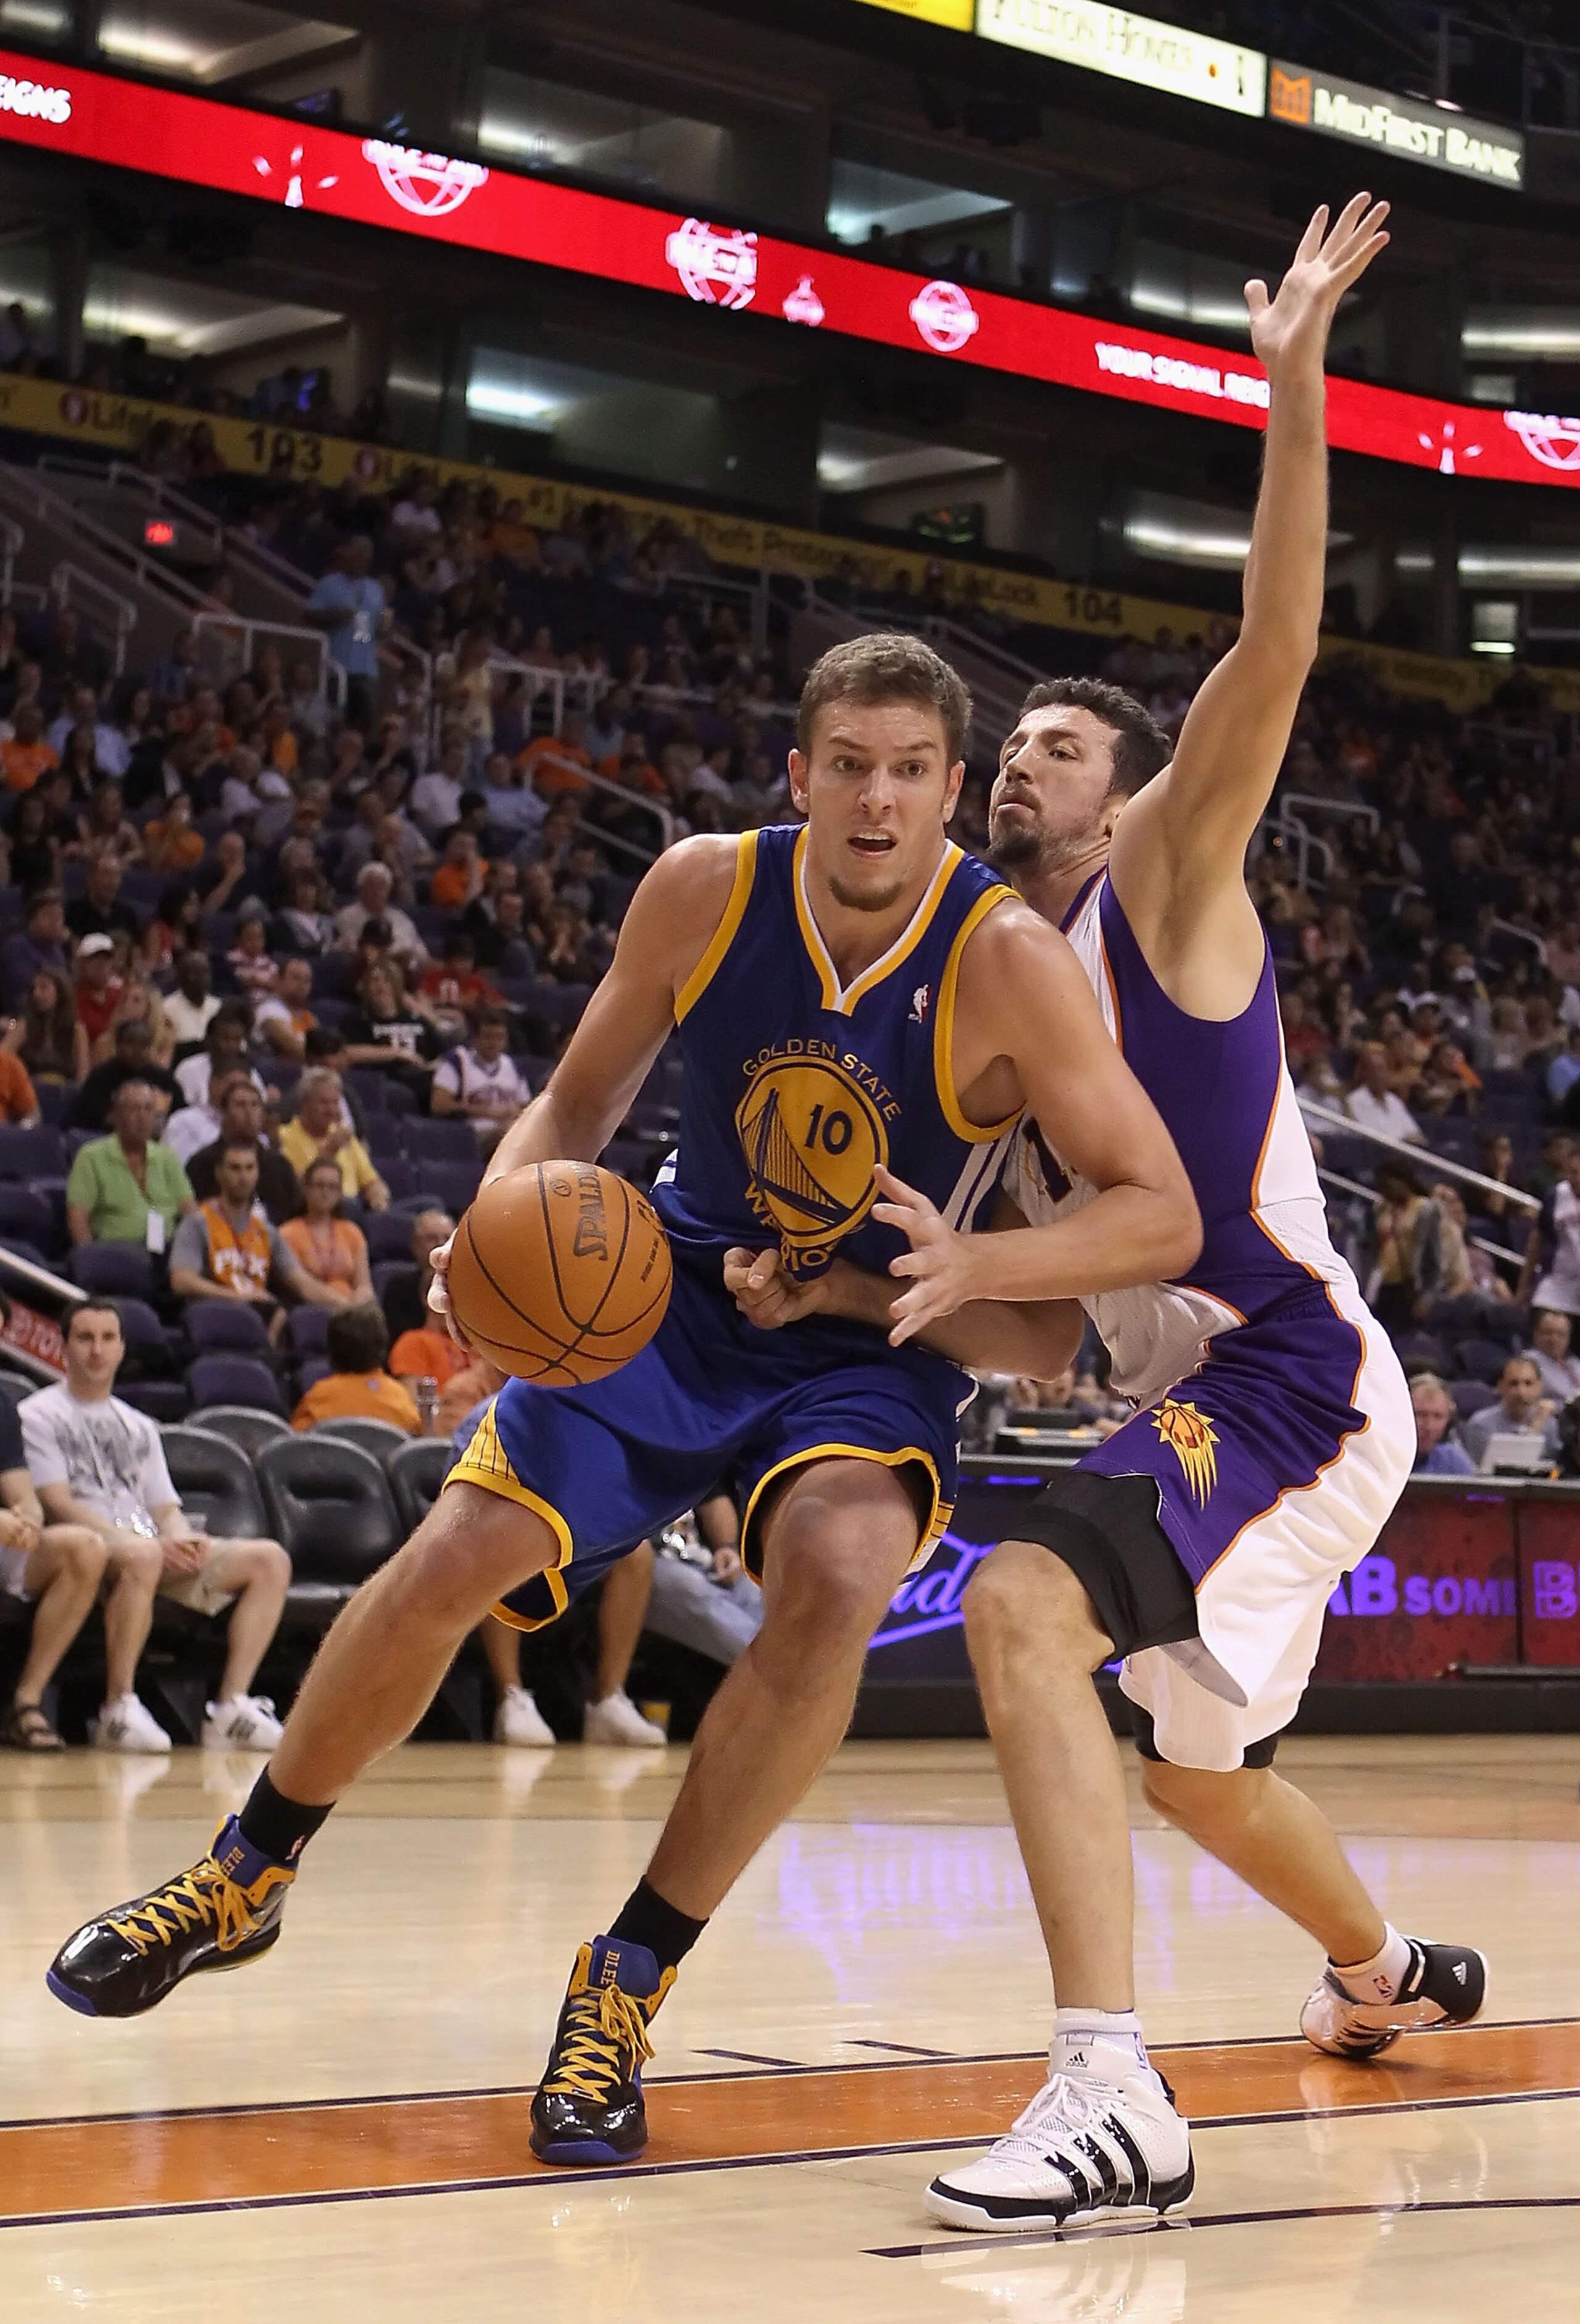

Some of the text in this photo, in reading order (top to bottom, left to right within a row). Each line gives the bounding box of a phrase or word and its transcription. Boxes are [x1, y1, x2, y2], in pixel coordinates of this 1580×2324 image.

[247, 430, 322, 473] 103
[1064, 589, 1121, 627] 104
[742, 1039, 902, 1121] GOLDEN STATE
[804, 1104, 852, 1155] 10
[601, 1950, 620, 1985] DLEE
